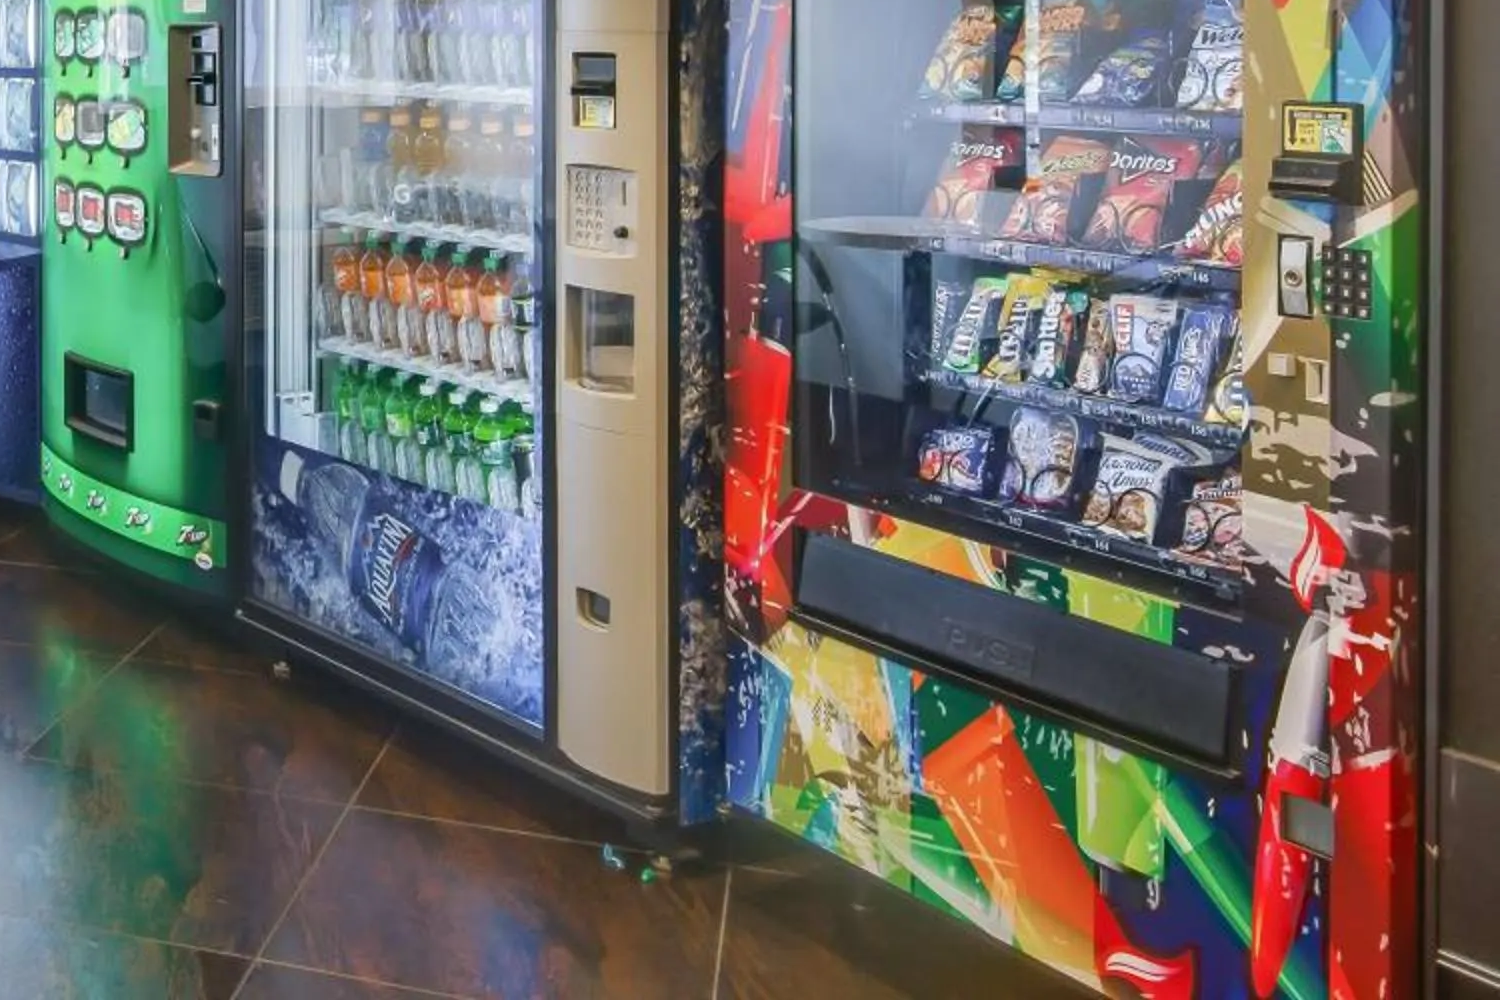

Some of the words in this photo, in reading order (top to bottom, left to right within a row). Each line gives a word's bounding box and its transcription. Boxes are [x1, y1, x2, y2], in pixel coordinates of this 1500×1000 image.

[1110, 151, 1178, 173] Doritos
[1116, 305, 1131, 344] CLIF
[366, 512, 414, 627] AQUAFINA
